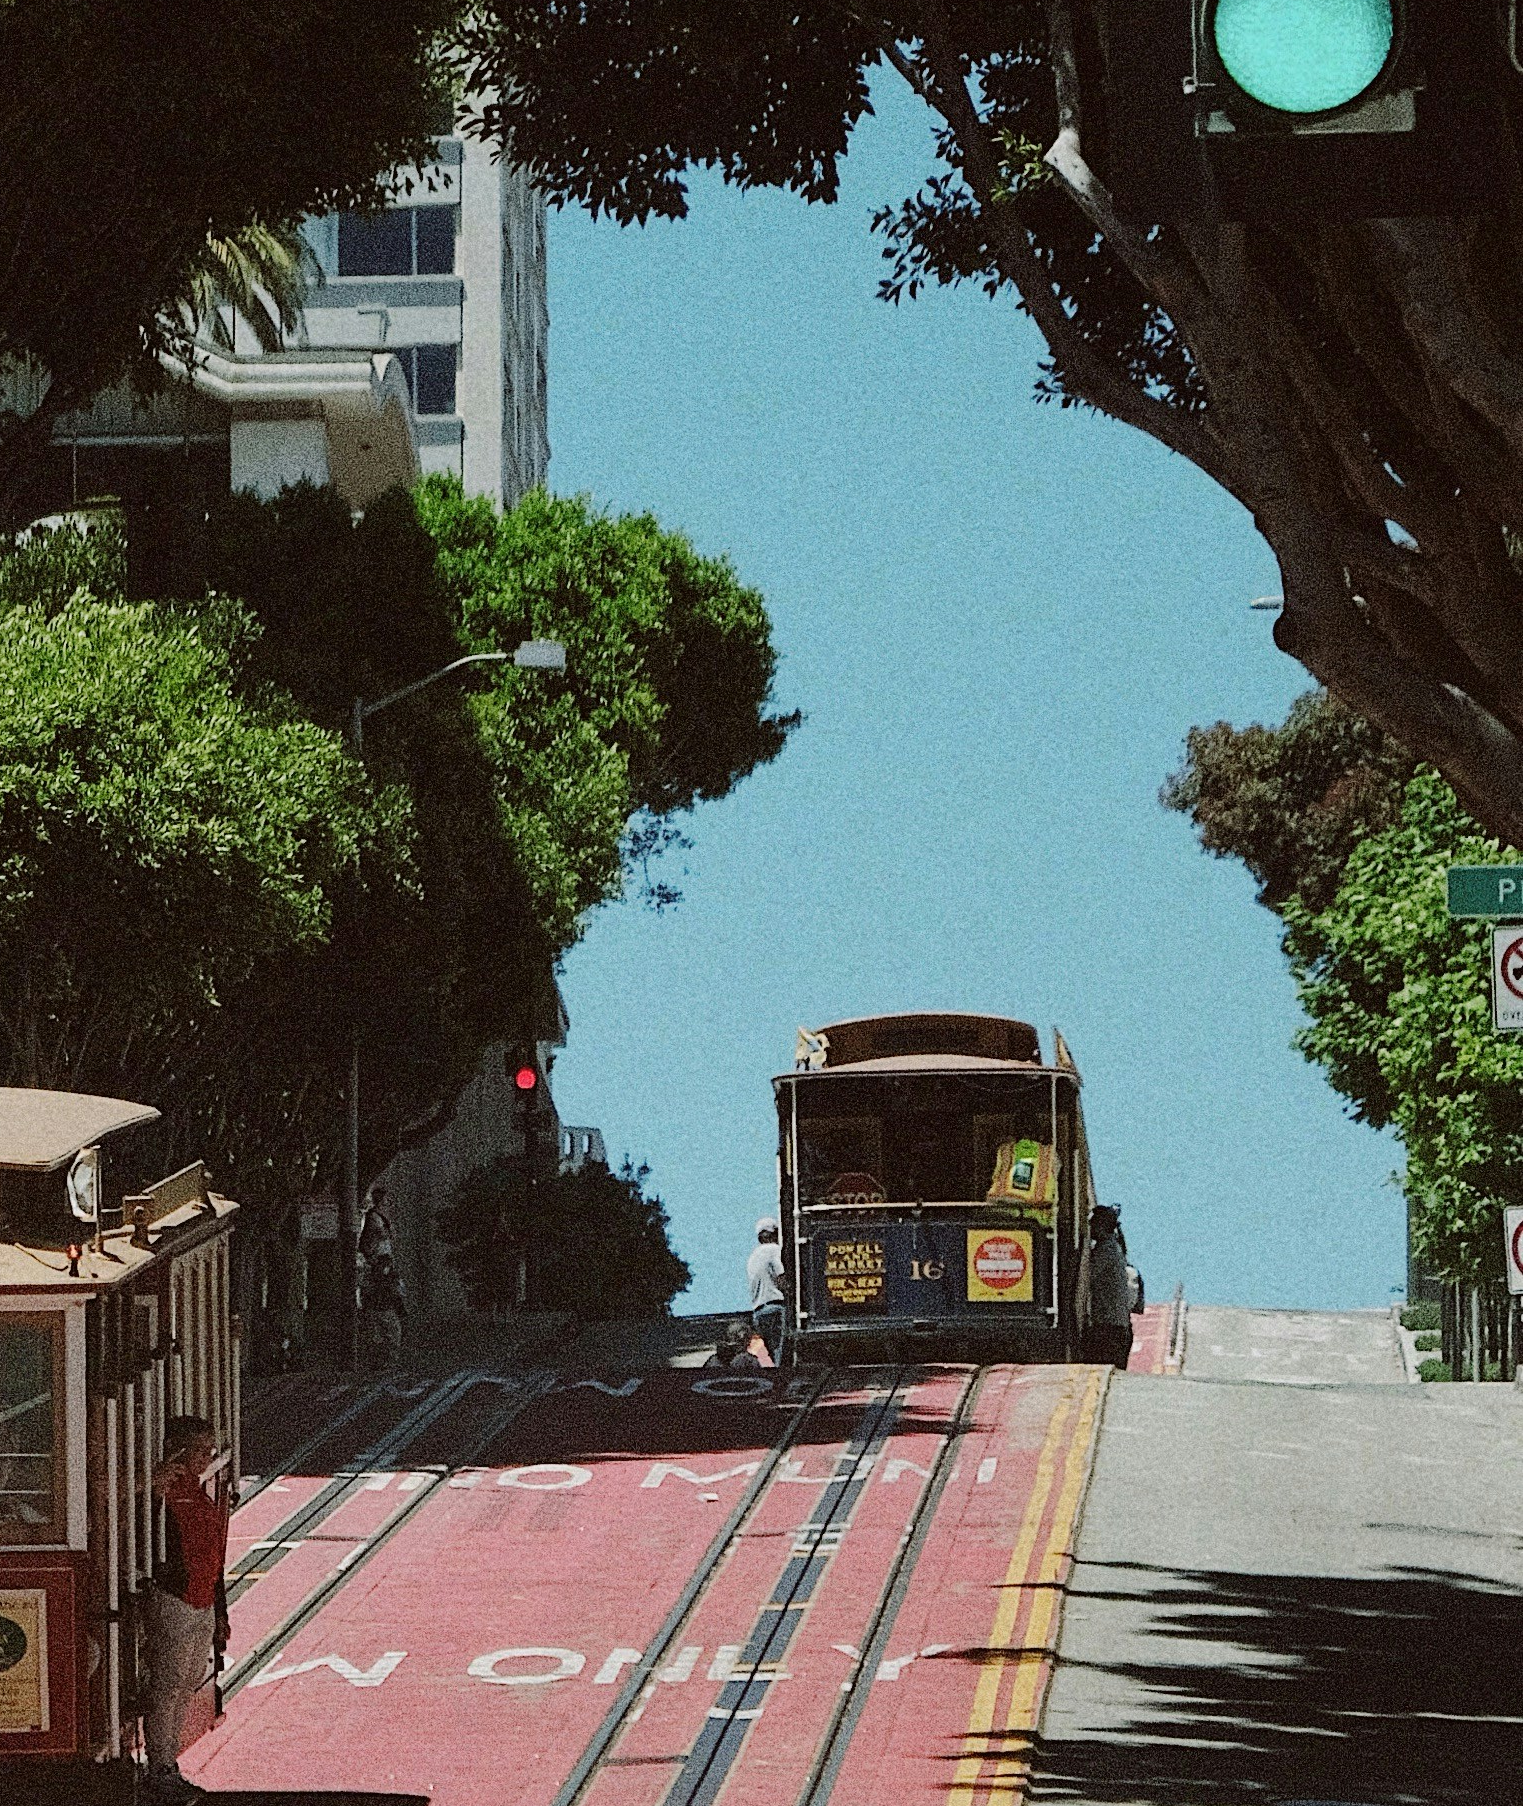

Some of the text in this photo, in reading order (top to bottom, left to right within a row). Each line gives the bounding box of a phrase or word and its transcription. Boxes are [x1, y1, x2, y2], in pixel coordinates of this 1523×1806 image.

[1498, 878, 1523, 904] P
[828, 1243, 883, 1255] POWELL
[843, 1253, 870, 1261] AND
[827, 1259, 883, 1270] MARKET
[909, 1259, 945, 1281] 16
[640, 1454, 999, 1487] MUNI
[467, 1643, 952, 1686] ONLY
